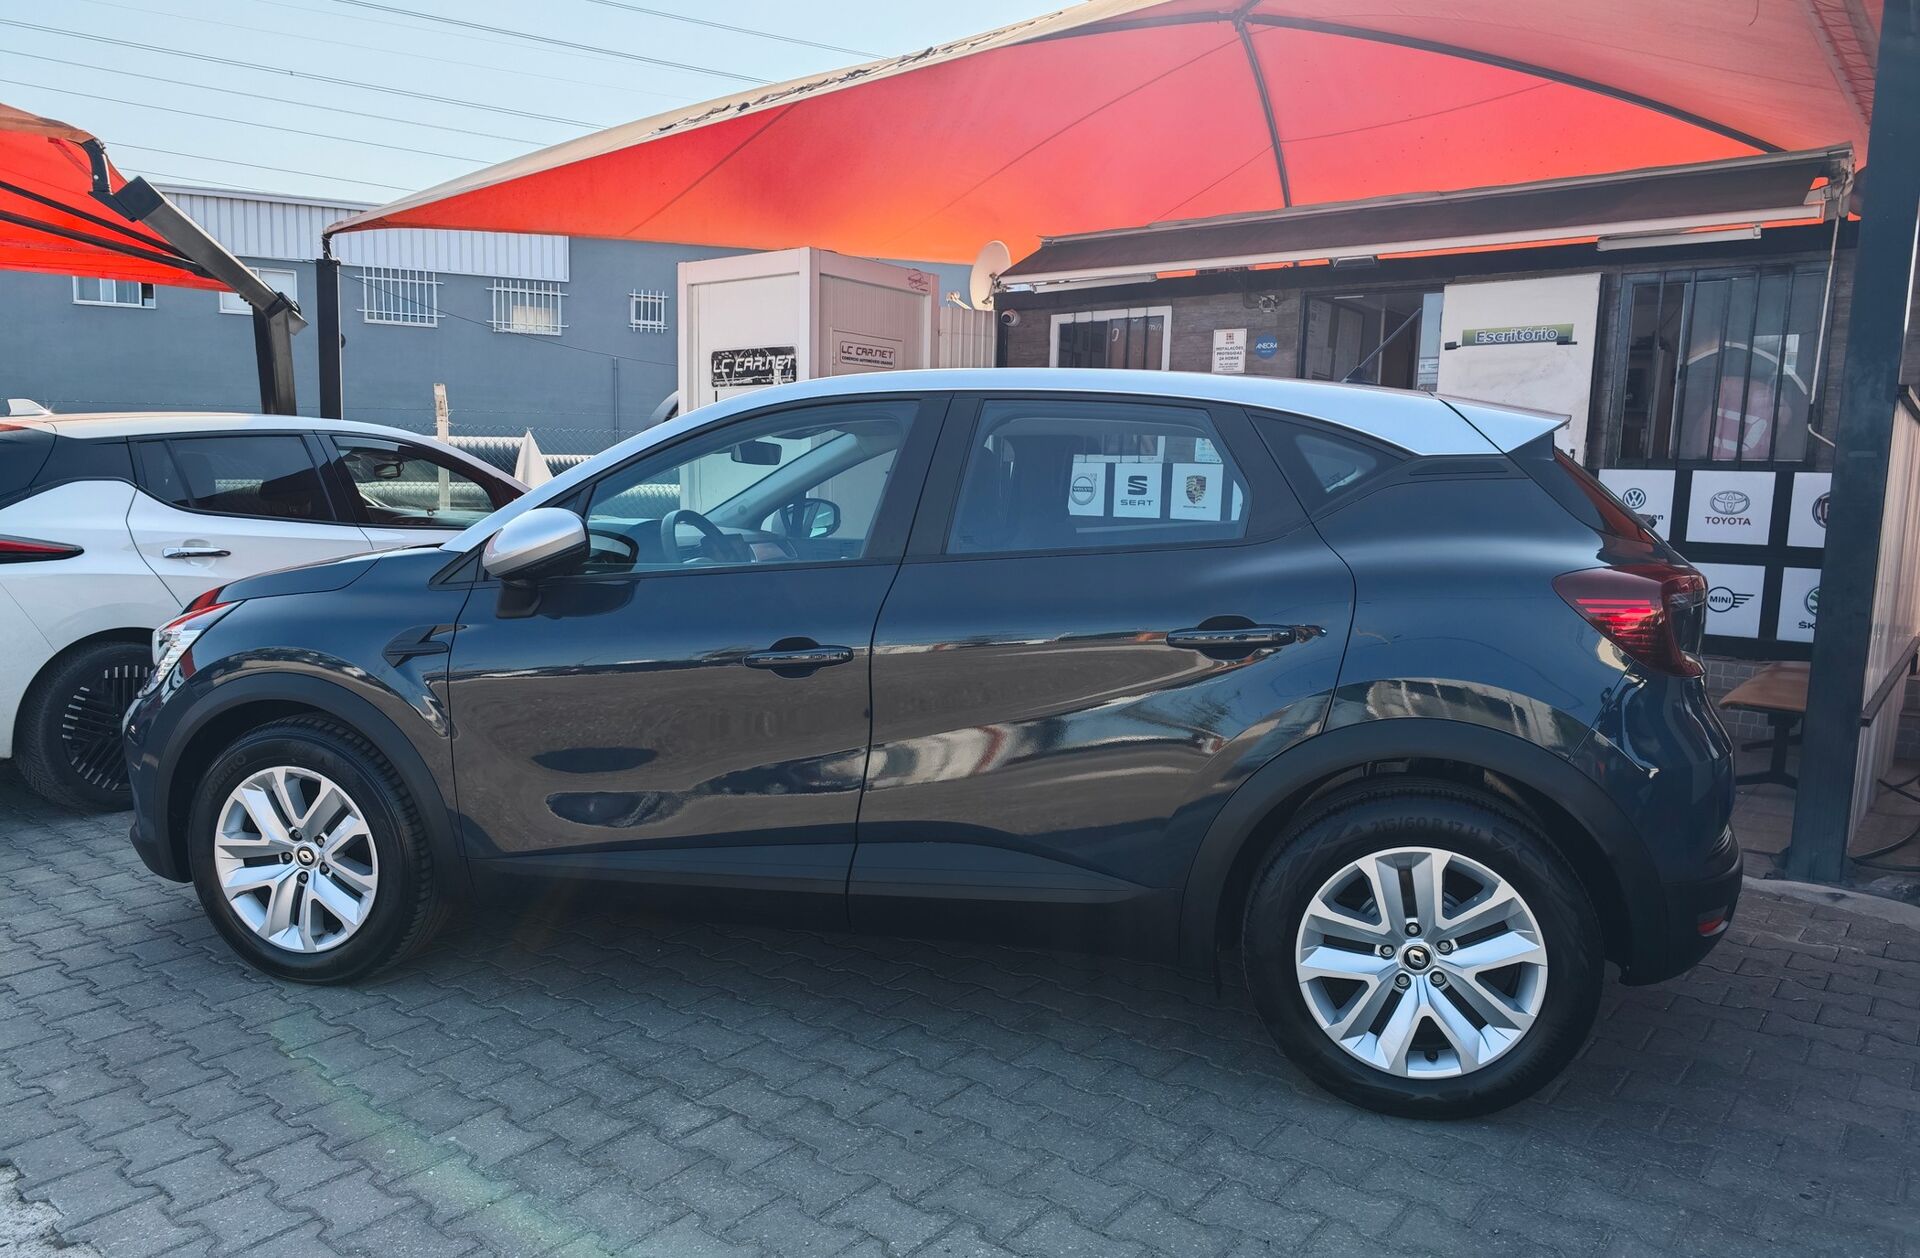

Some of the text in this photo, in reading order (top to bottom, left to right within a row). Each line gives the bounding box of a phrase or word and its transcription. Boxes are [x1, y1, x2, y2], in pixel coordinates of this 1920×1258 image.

[1475, 327, 1559, 344] Escritório
[841, 345, 854, 355] LC
[713, 358, 735, 373] LC
[1120, 499, 1154, 507] SEAT
[1704, 516, 1752, 526] TOYOTA
[1709, 595, 1732, 604] MINI
